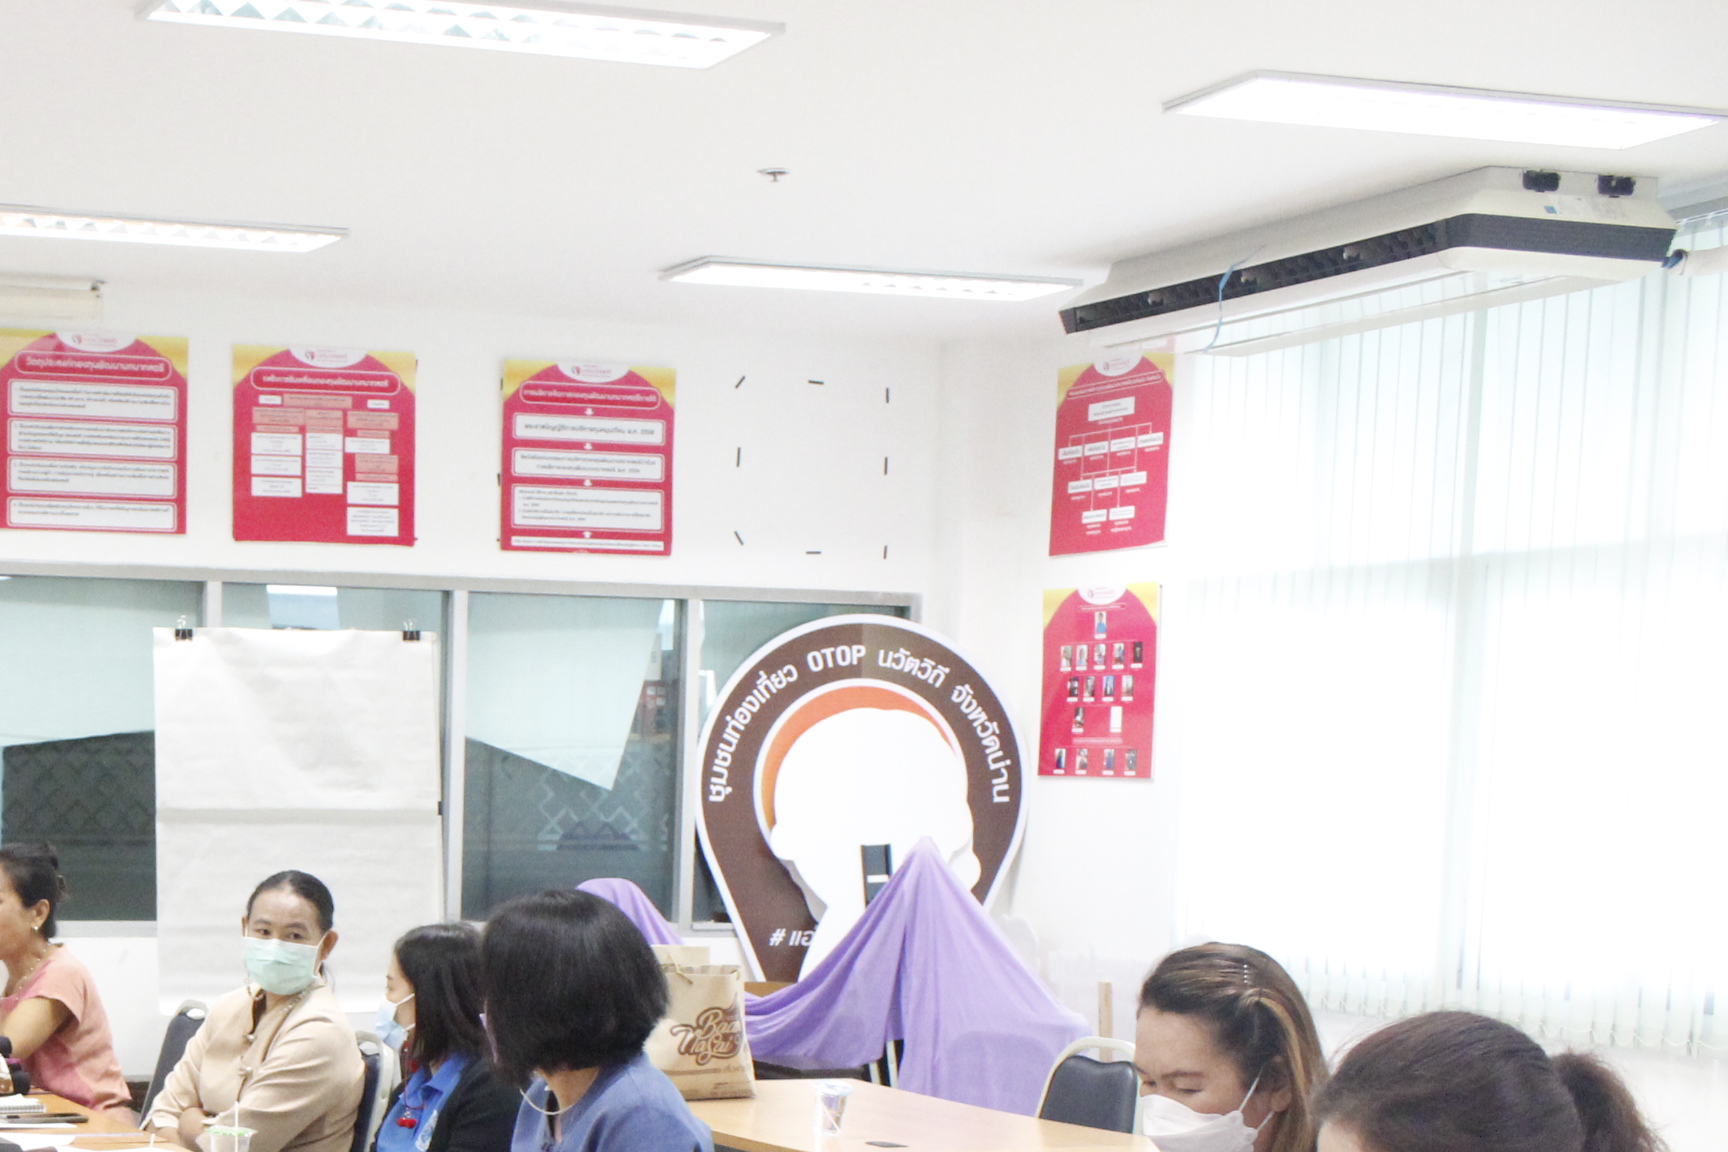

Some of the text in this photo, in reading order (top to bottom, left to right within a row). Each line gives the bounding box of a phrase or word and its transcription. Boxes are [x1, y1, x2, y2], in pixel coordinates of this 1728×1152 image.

[708, 644, 1010, 803] ชุมชนท่องเที่ยว OTOP นวัตวิถี จังหวัดน่าน
